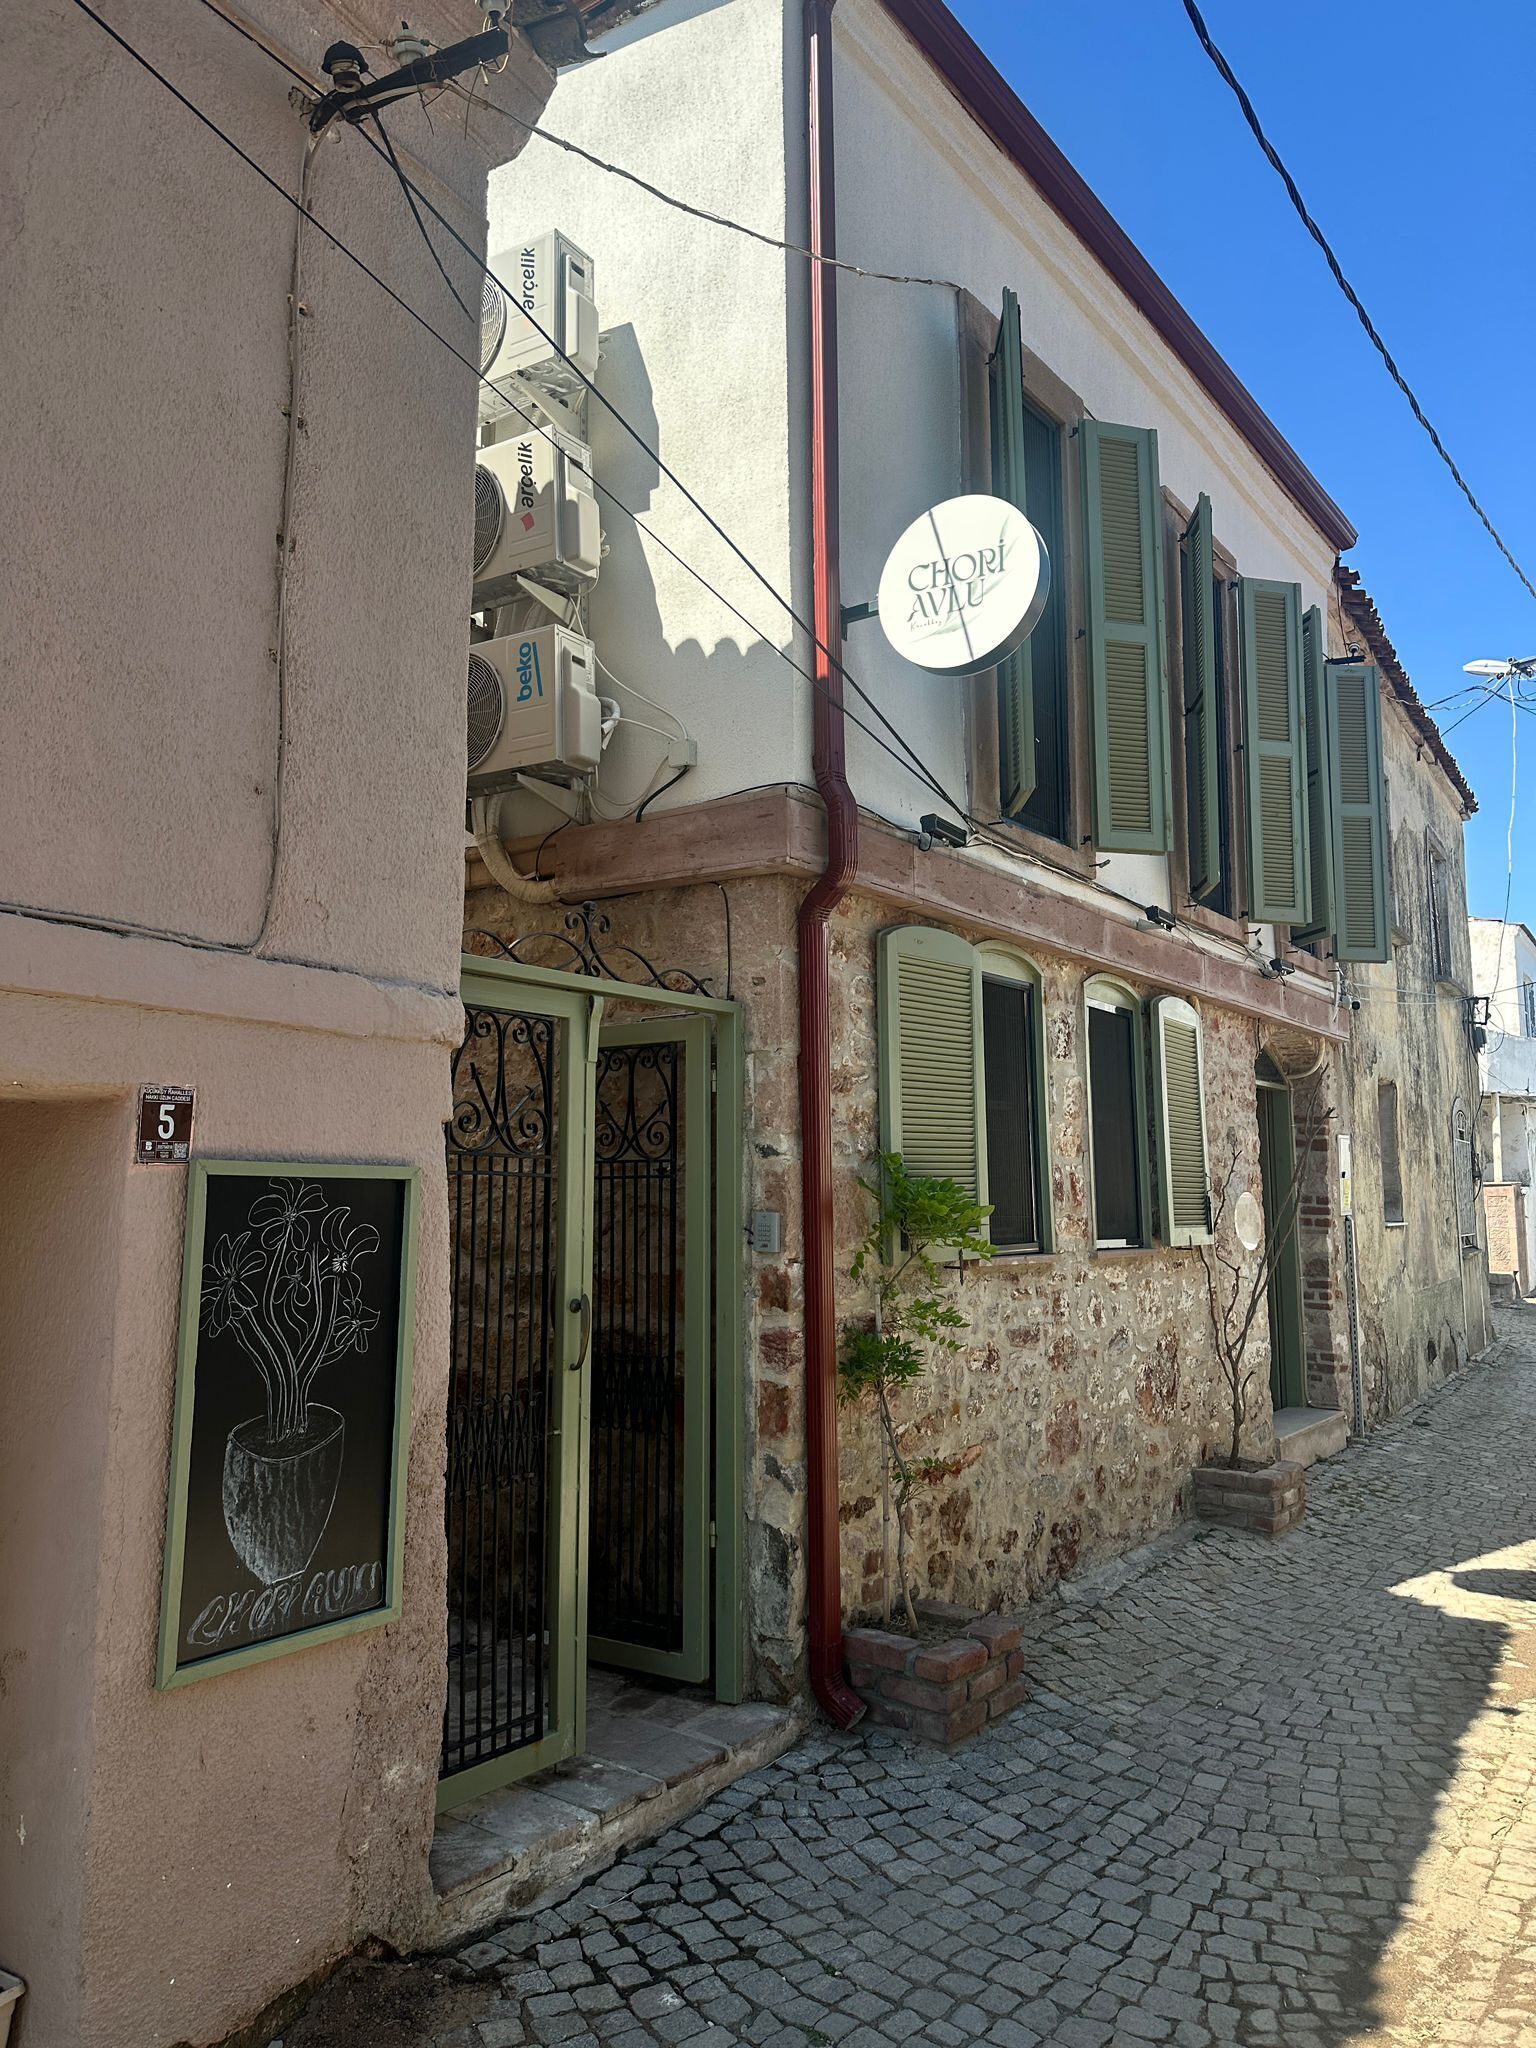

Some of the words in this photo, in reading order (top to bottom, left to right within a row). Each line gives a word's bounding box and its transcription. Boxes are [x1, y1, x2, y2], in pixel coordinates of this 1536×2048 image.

[521, 248, 538, 310] arçelik
[518, 442, 536, 508] arçelik
[908, 539, 1005, 591] CHORİ
[907, 578, 985, 622] AVLU
[516, 642, 532, 702] beko
[158, 1104, 176, 1139] 5
